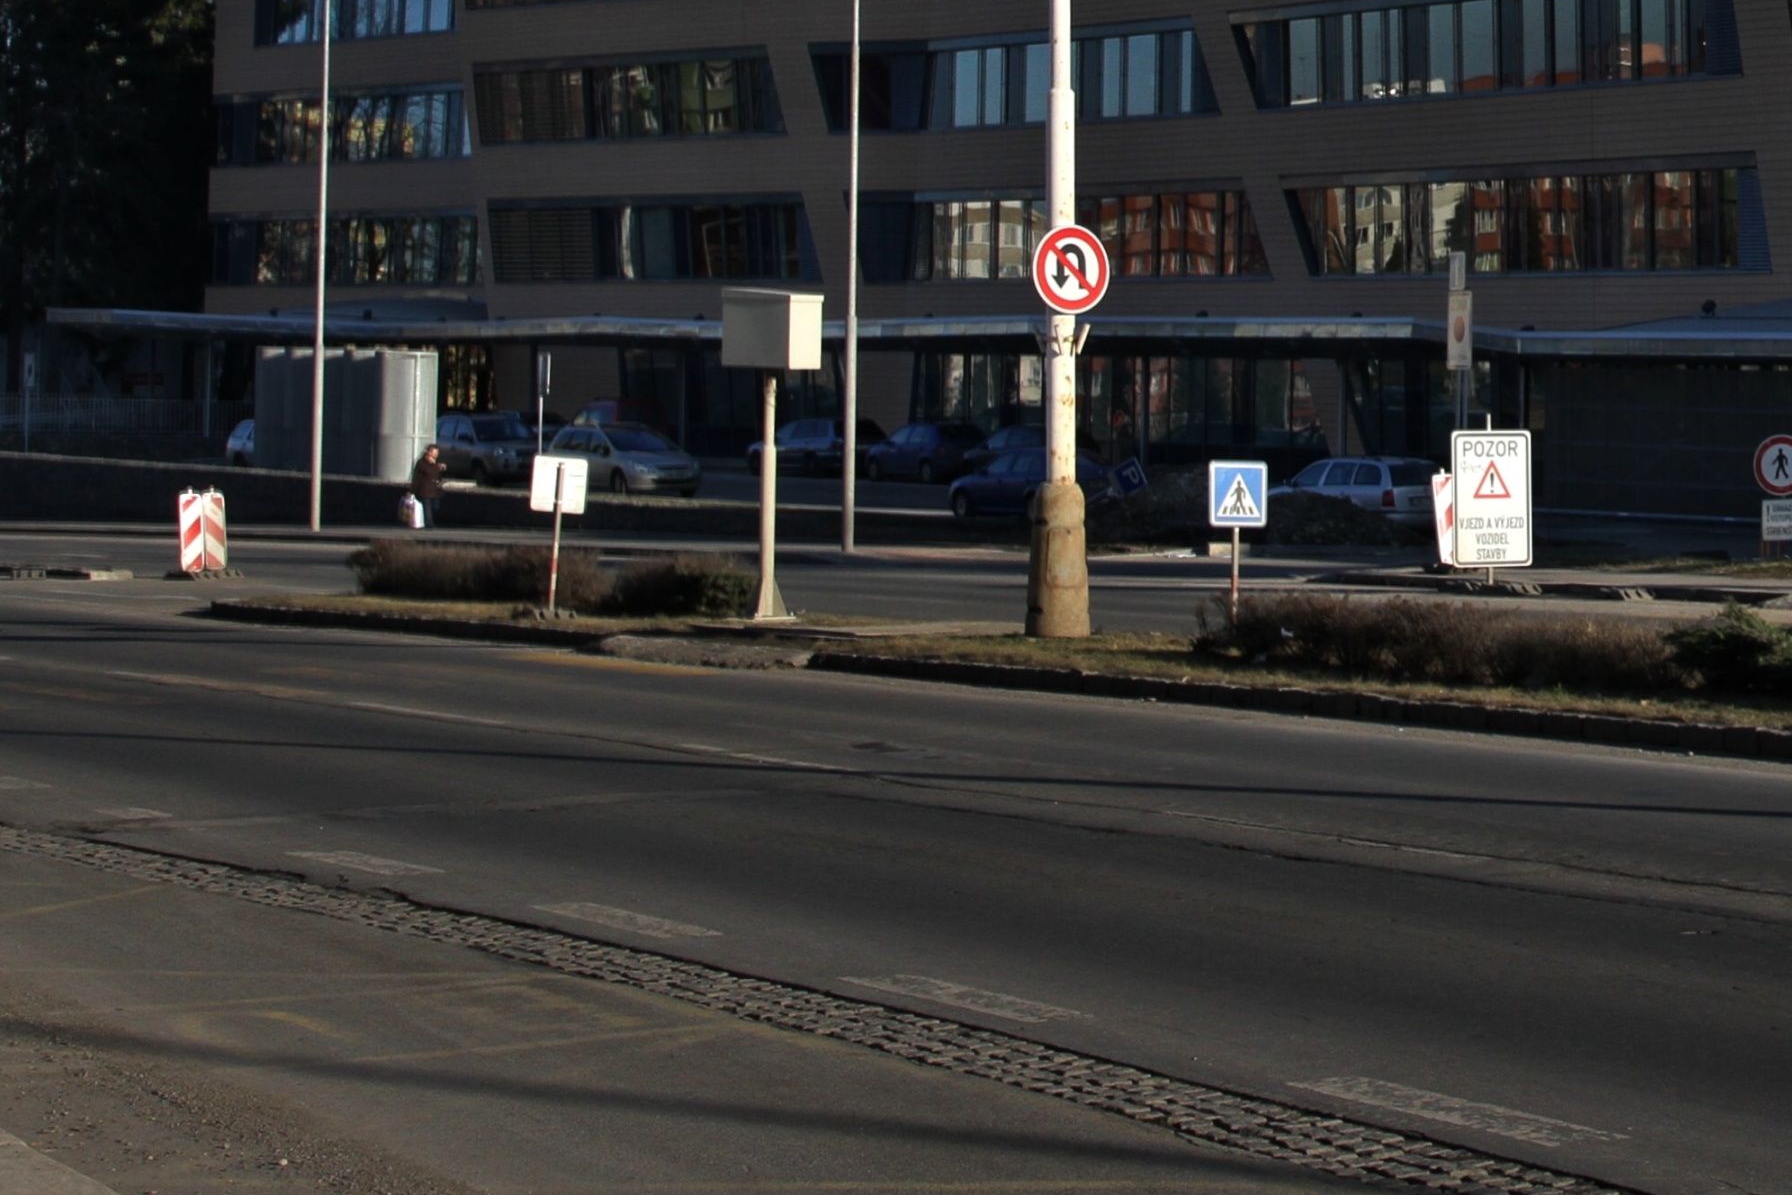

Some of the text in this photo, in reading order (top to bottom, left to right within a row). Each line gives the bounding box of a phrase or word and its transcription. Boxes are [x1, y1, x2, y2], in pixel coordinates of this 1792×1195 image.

[1463, 440, 1518, 457] POZOR
[1122, 465, 1139, 484] P
[1459, 515, 1524, 529] VJEZD A VÝJEZD
[1475, 533, 1509, 544] VOZIDEL
[1476, 548, 1507, 560] STAVBY
